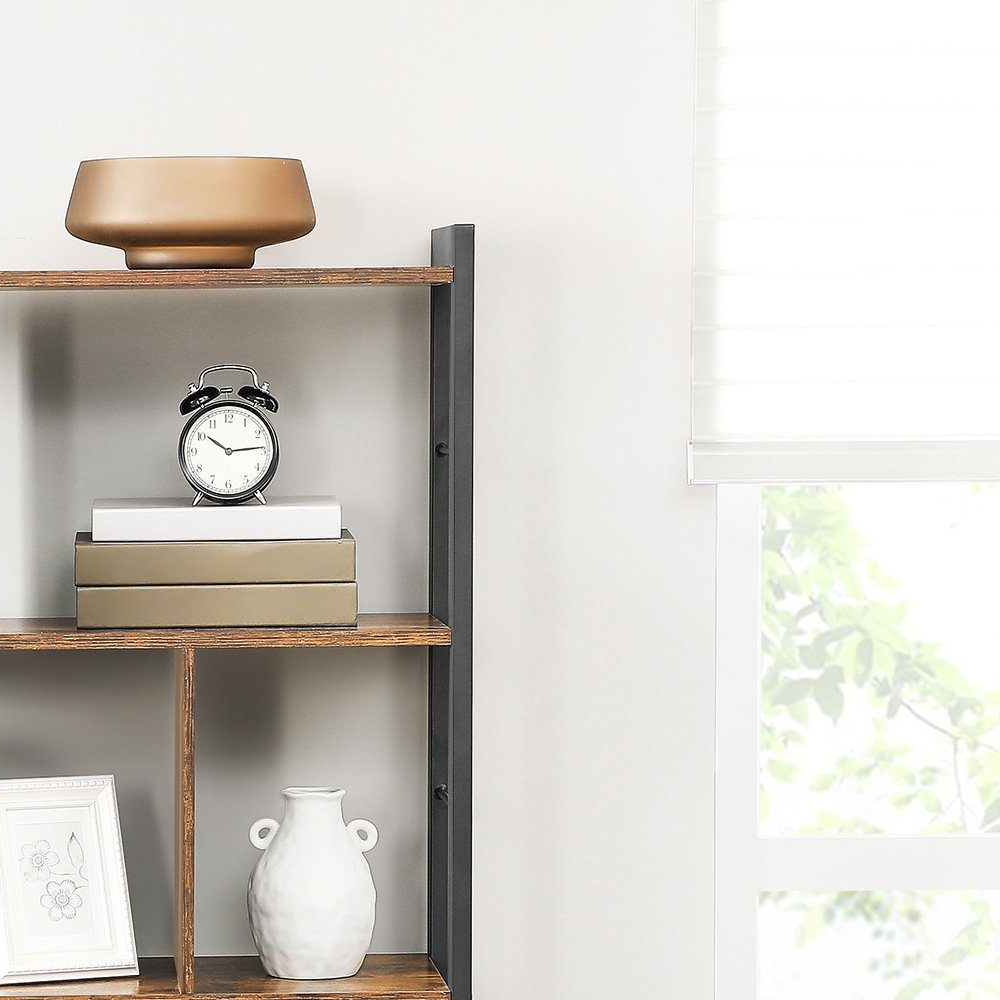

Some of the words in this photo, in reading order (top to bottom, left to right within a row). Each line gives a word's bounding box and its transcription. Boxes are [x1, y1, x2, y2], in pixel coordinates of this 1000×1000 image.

[224, 414, 233, 423] 12
[209, 419, 216, 429] 11
[197, 432, 206, 441] 10
[255, 430, 261, 439] 2
[190, 447, 198, 456] 9
[196, 464, 203, 473] 8
[210, 474, 215, 484] 7
[225, 480, 232, 489] 6
